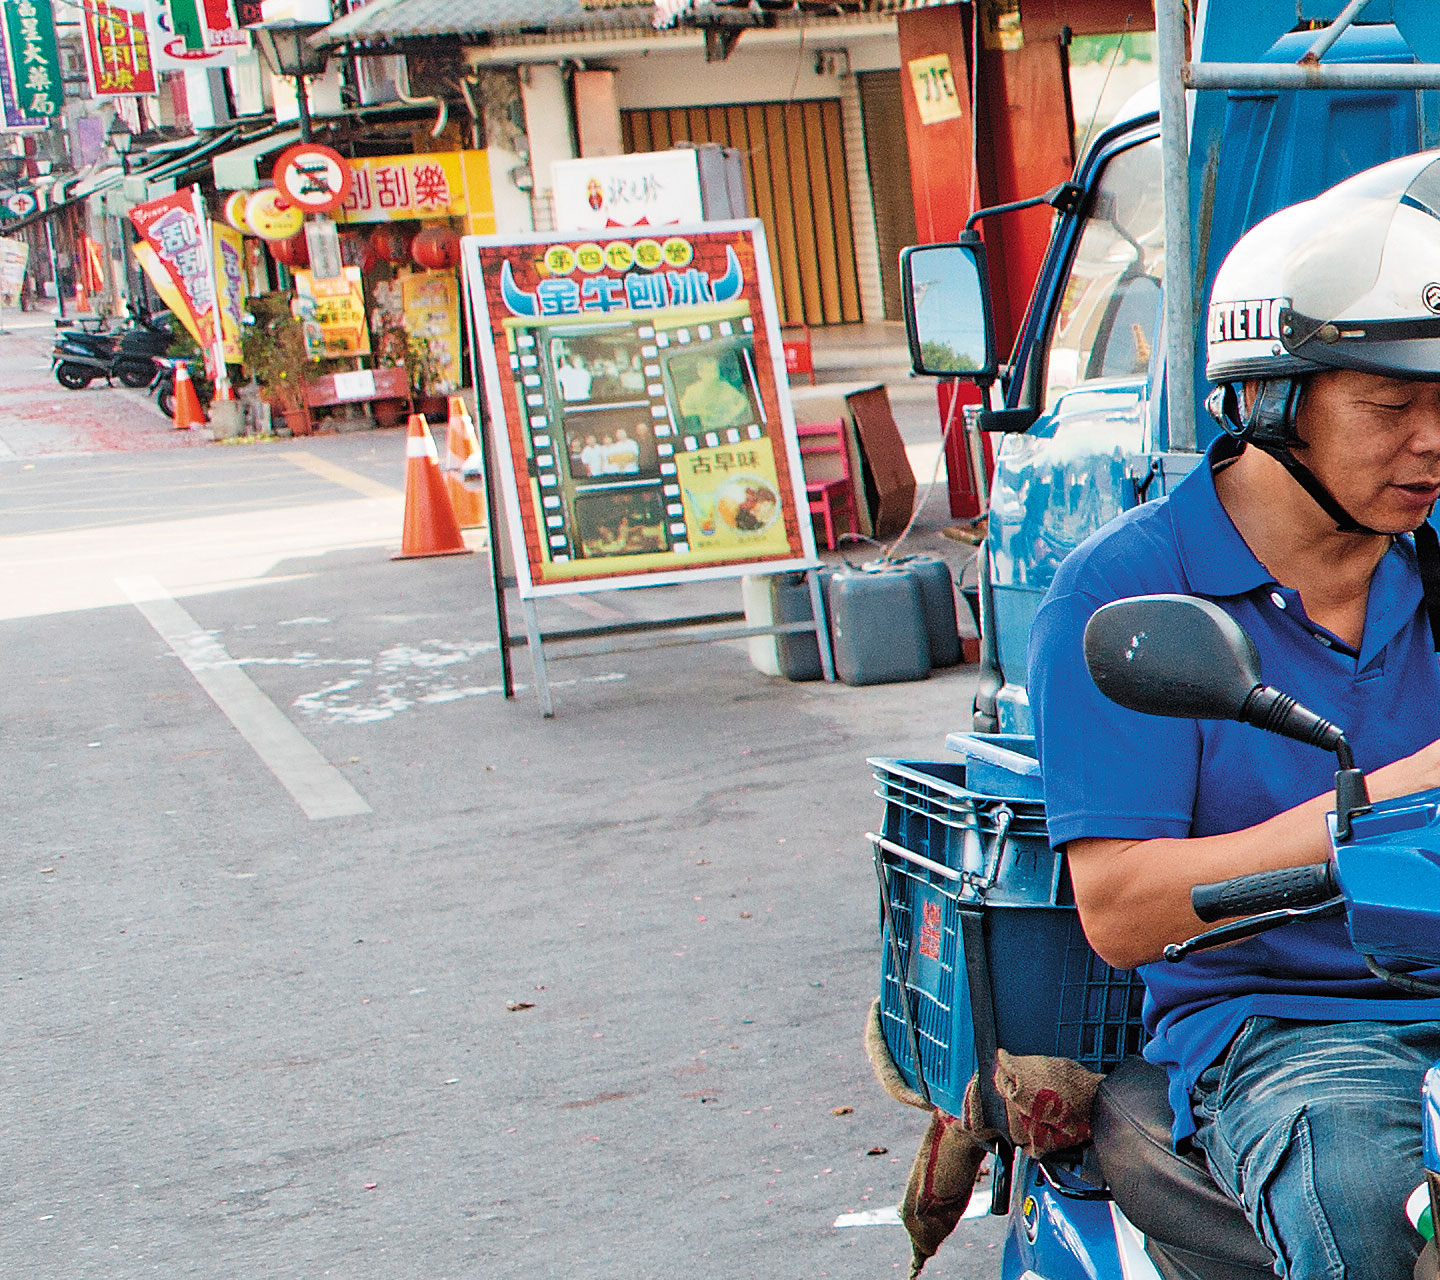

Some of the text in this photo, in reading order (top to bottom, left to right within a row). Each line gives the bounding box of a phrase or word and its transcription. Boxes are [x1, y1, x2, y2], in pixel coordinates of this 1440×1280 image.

[536, 270, 711, 317] 金牛刨冰
[689, 450, 761, 475] 古早味
